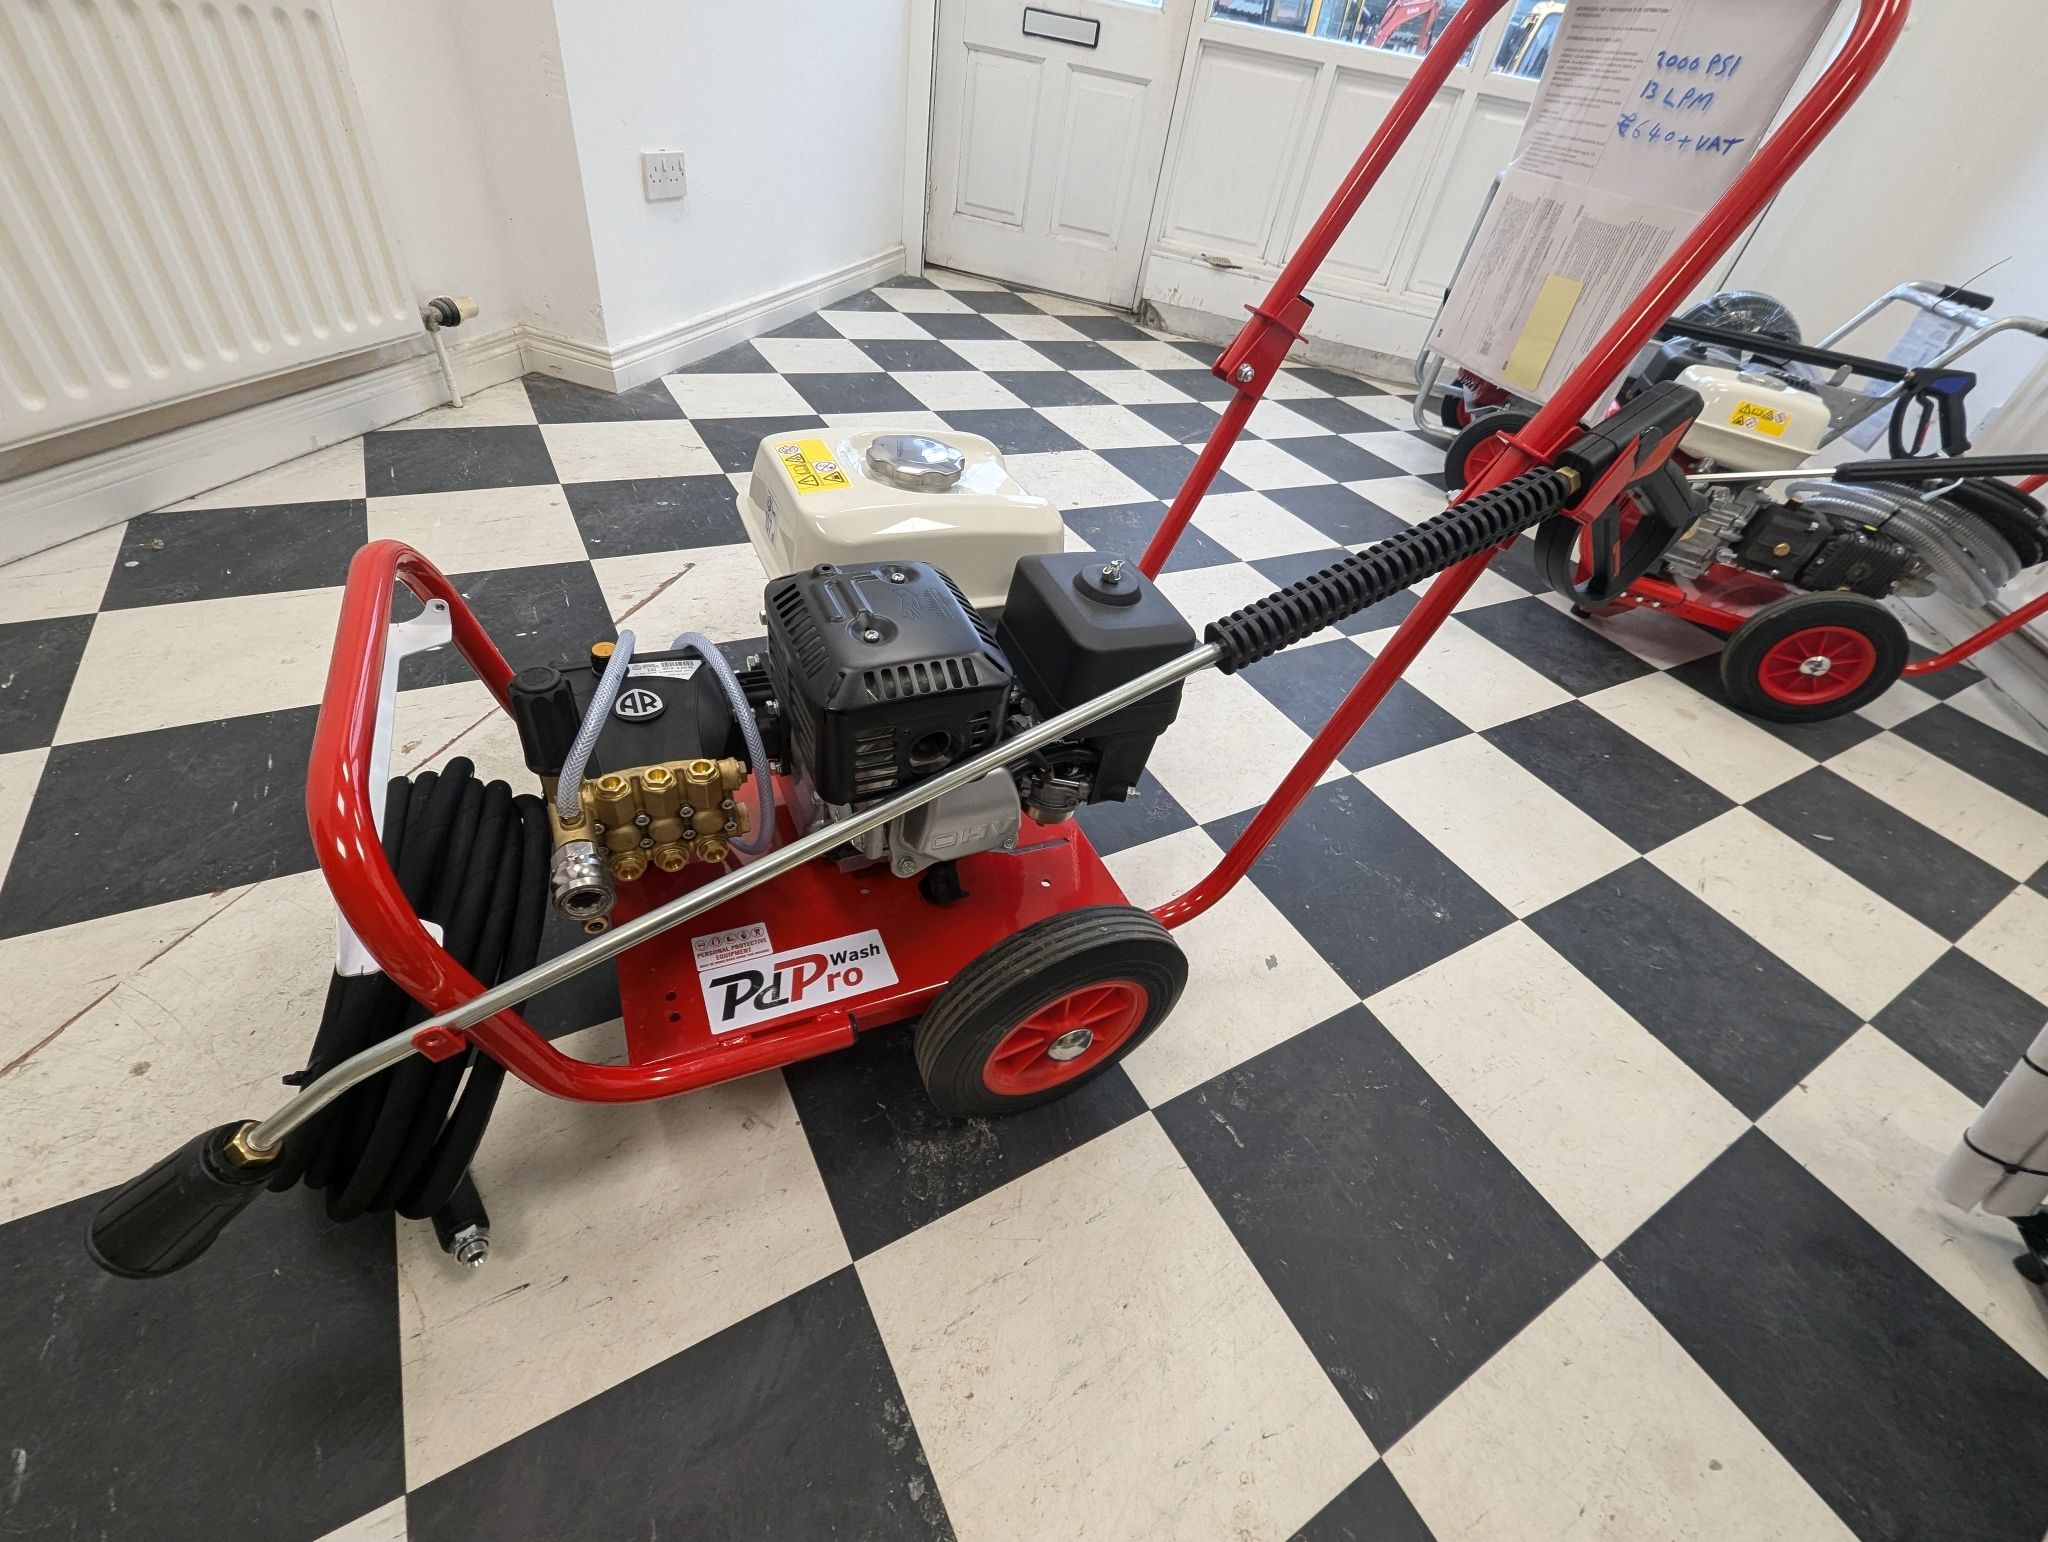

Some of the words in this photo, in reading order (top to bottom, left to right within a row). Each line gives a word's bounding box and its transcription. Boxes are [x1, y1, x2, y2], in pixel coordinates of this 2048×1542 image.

[1706, 53, 1742, 76] PSI
[1640, 80, 1659, 99] 13
[1663, 87, 1714, 111] LPM
[620, 691, 658, 714] AR
[931, 816, 1017, 850] OHV
[697, 945, 730, 959] PERSONAL
[731, 937, 767, 951] PROTECTIVE
[715, 947, 752, 961] EQUIPMENT
[830, 943, 881, 967] Wash
